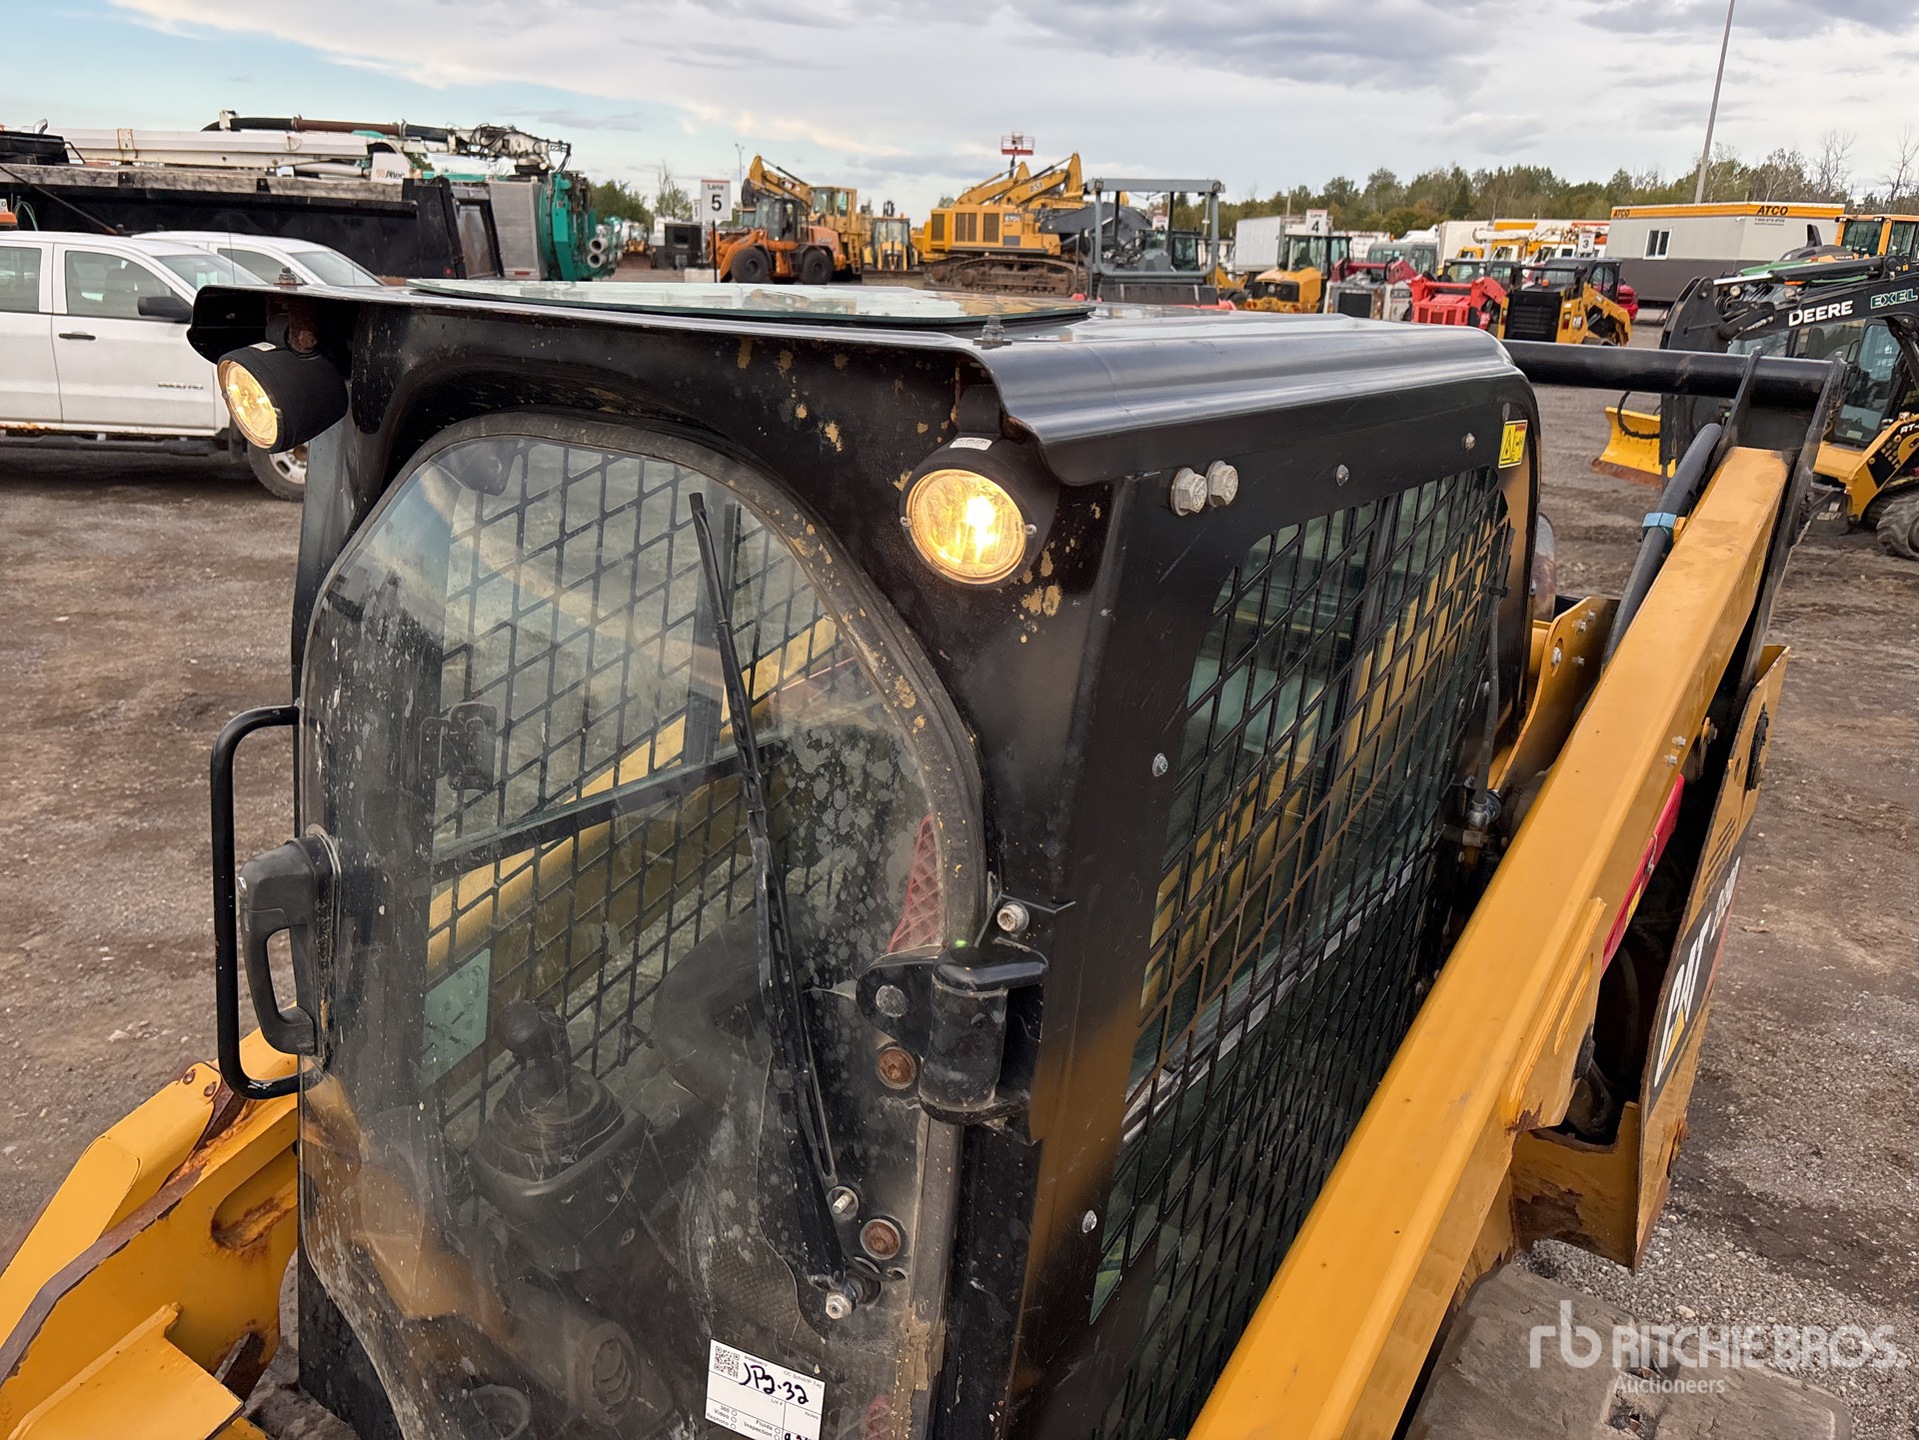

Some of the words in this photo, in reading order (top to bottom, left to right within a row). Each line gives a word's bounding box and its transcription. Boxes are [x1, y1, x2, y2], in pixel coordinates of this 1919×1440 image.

[711, 193, 722, 212] 5
[1613, 209, 1630, 217] ATCO
[1757, 205, 1788, 216] ATCO
[1311, 220, 1319, 233] 4
[1582, 239, 1589, 249] 3
[1870, 288, 1919, 309] EXEL
[1788, 300, 1853, 327] DEERE
